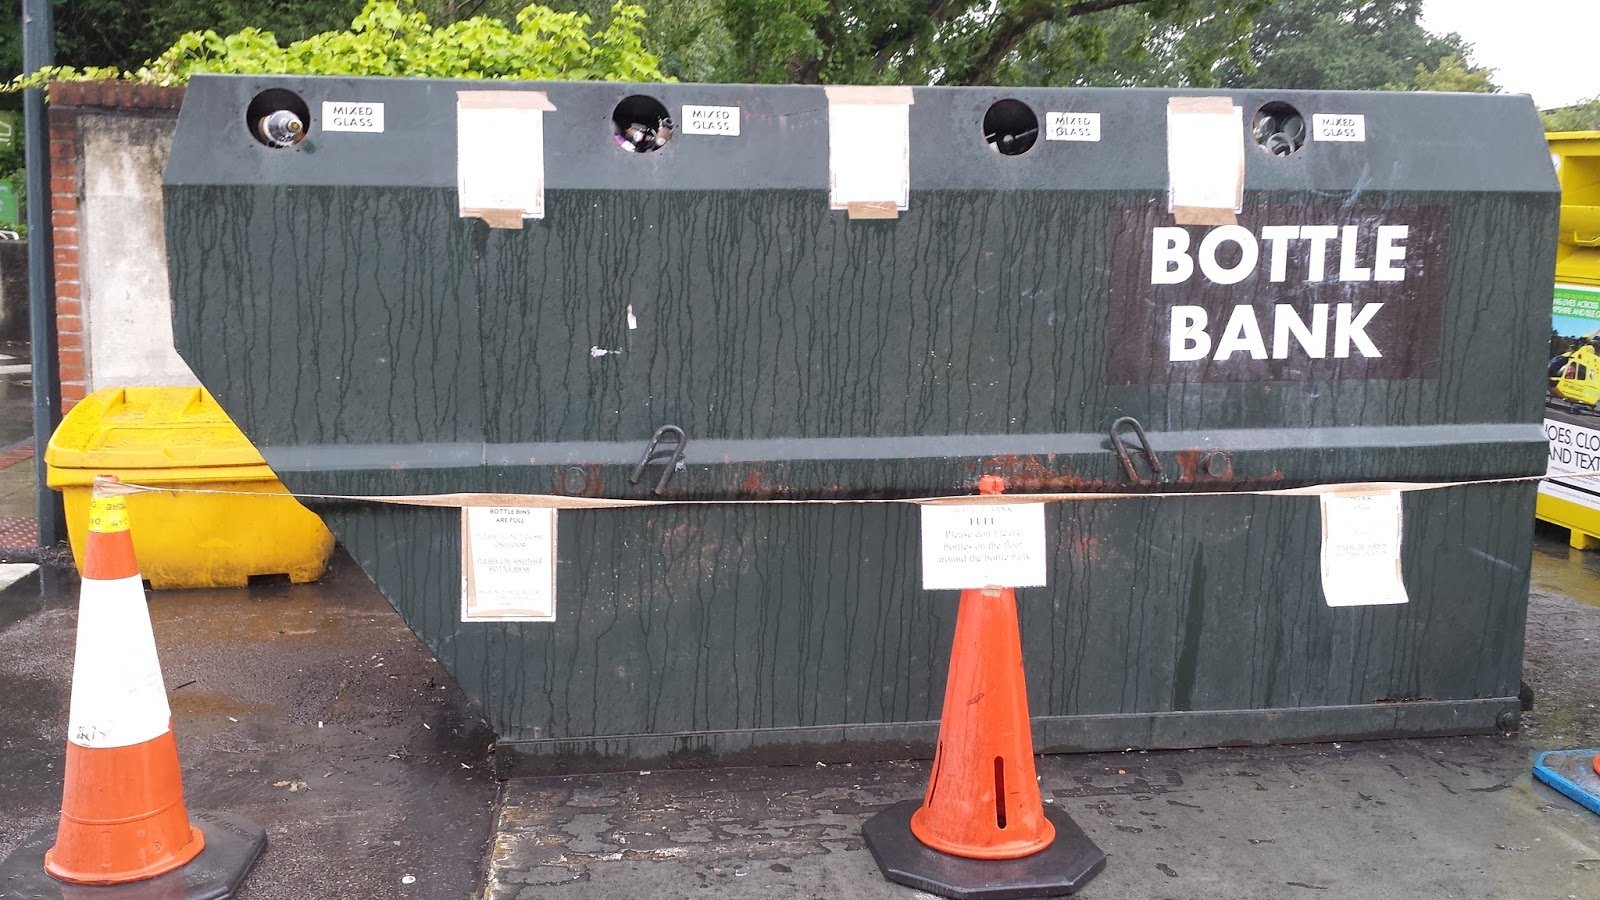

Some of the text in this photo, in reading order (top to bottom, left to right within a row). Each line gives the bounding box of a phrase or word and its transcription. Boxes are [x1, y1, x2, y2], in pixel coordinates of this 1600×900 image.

[333, 107, 373, 115] MIXED
[693, 110, 729, 119] MIXED
[333, 118, 373, 126] GLASS
[693, 120, 729, 130] GLASS
[1056, 116, 1090, 125] MIXED
[1322, 118, 1355, 126] MIXED
[1056, 126, 1090, 136] GLASS
[1323, 128, 1356, 137] GLASS
[1151, 224, 1409, 284] BOTTLE
[1576, 300, 1600, 310] ACROSS
[1169, 302, 1385, 362] BANK
[945, 530, 972, 538] Please
[944, 542, 972, 551] bottles
[936, 554, 967, 564] around
[968, 554, 982, 562] the
[984, 553, 1009, 562] bottle
